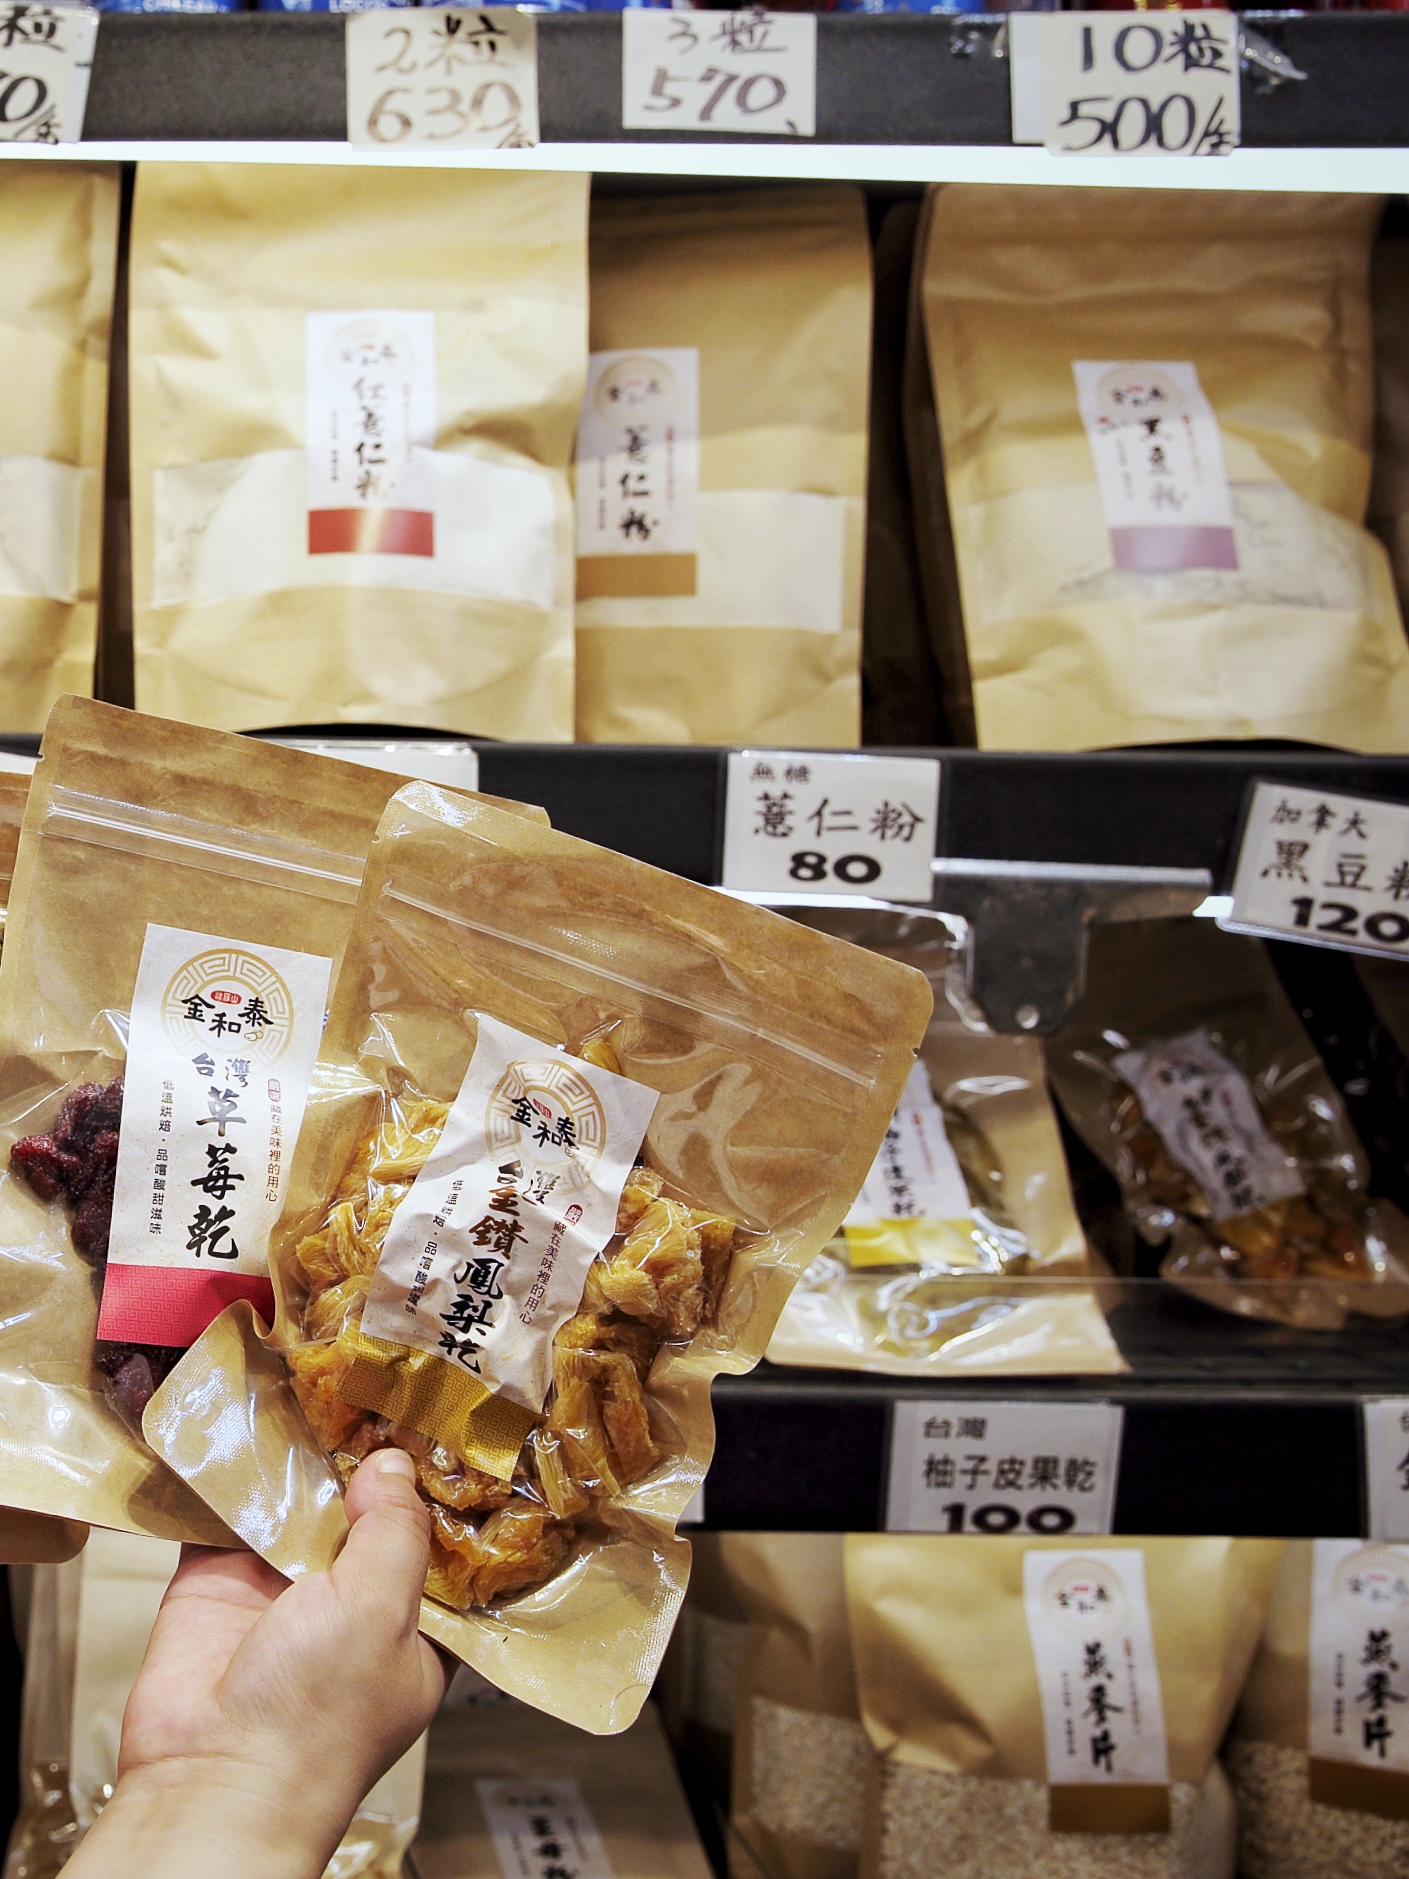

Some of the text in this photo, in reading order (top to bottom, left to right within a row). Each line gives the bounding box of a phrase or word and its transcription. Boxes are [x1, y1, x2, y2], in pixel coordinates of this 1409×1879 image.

[375, 14, 513, 76] 2粒
[668, 5, 789, 56] 3粒
[1081, 18, 1231, 76] 10粒
[643, 67, 786, 121] 570
[750, 761, 812, 784] 無糖
[752, 790, 925, 843] 薏仁粉
[1270, 799, 1367, 840] 加拿大
[789, 850, 882, 884] 80
[1291, 897, 1409, 943] 120
[181, 994, 274, 1038] 金和泰
[191, 1052, 252, 1088] 台灣
[510, 1096, 580, 1149] 金和泰
[185, 1085, 247, 1260] 草莓乾
[922, 1416, 988, 1440] 台灣
[922, 1453, 1098, 1493] 柚子皮果乾
[941, 1502, 1076, 1534] 100
